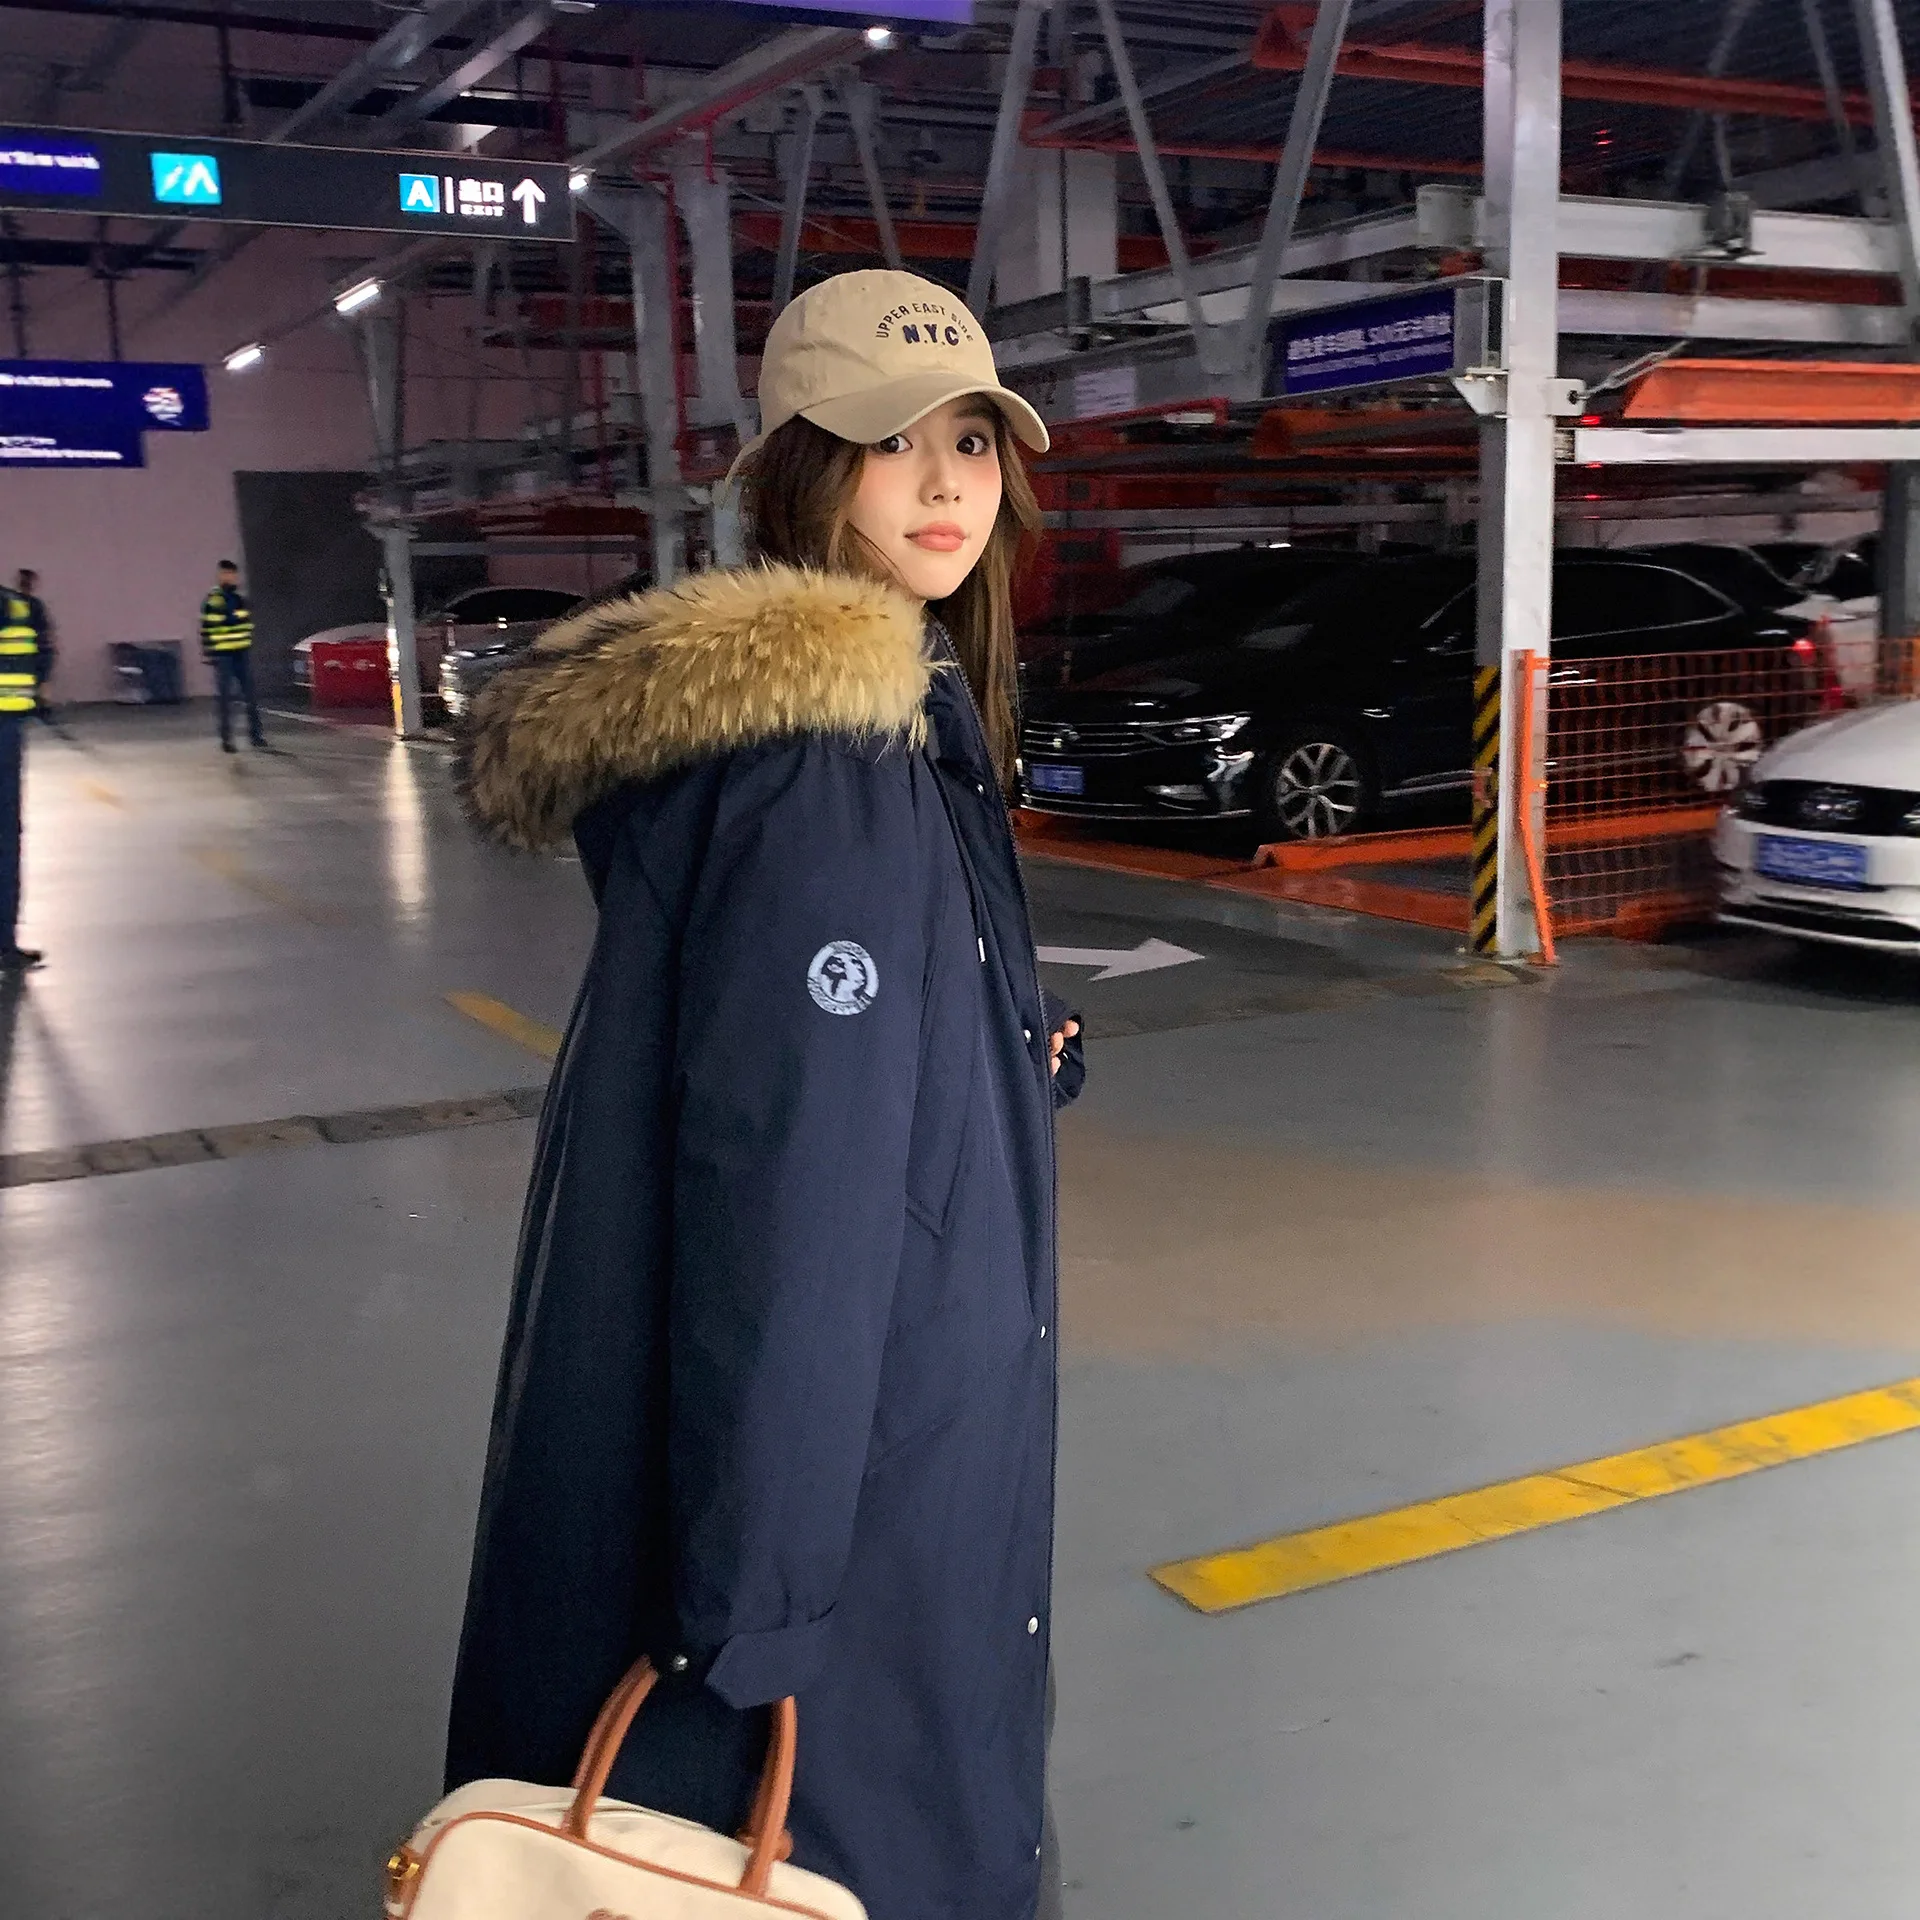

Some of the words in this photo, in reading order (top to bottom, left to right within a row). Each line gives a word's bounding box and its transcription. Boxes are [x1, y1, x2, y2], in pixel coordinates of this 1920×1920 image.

[406, 180, 433, 208] A
[459, 178, 504, 203] 出口
[460, 203, 505, 217] EXIT
[875, 305, 910, 339] UPPER
[912, 303, 946, 316] EAST
[902, 323, 960, 346] N.Y.C
